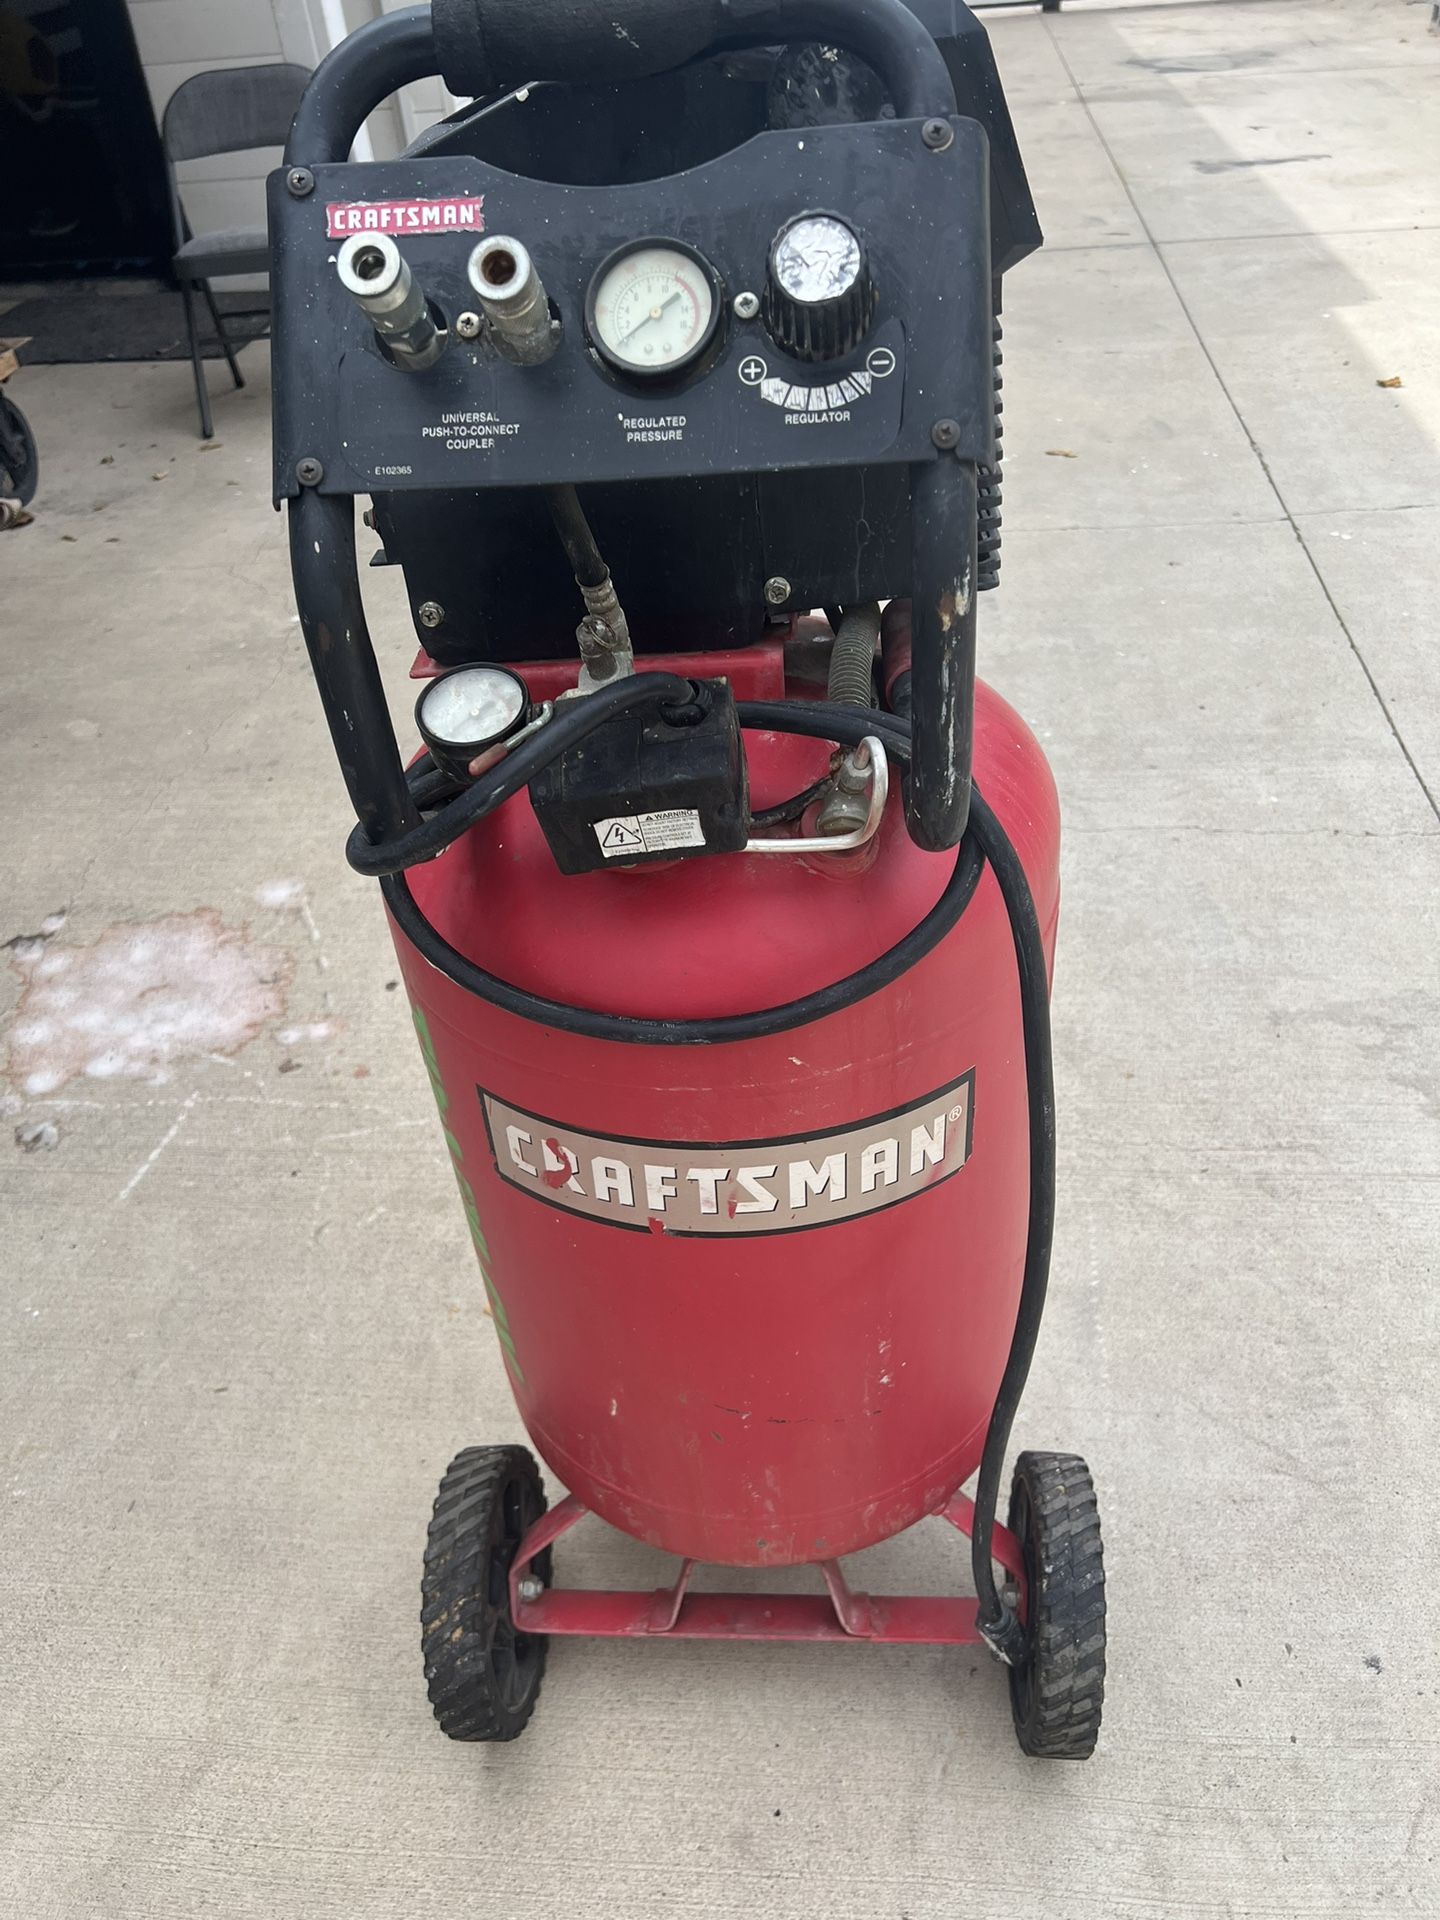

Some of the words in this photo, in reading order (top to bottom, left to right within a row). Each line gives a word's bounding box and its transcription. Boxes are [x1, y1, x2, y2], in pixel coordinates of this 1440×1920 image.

[333, 203, 474, 230] CRAFTSMAN
[441, 411, 500, 424] UNIVERSAL
[623, 415, 687, 429] REGULATED
[784, 410, 851, 425] REGULATOR
[422, 424, 520, 437] PUSH-TO-CONNECT
[627, 429, 683, 442] PRESSURE
[446, 438, 495, 450] COUPLER
[374, 465, 413, 476] E102365
[654, 809, 694, 820] WARNING
